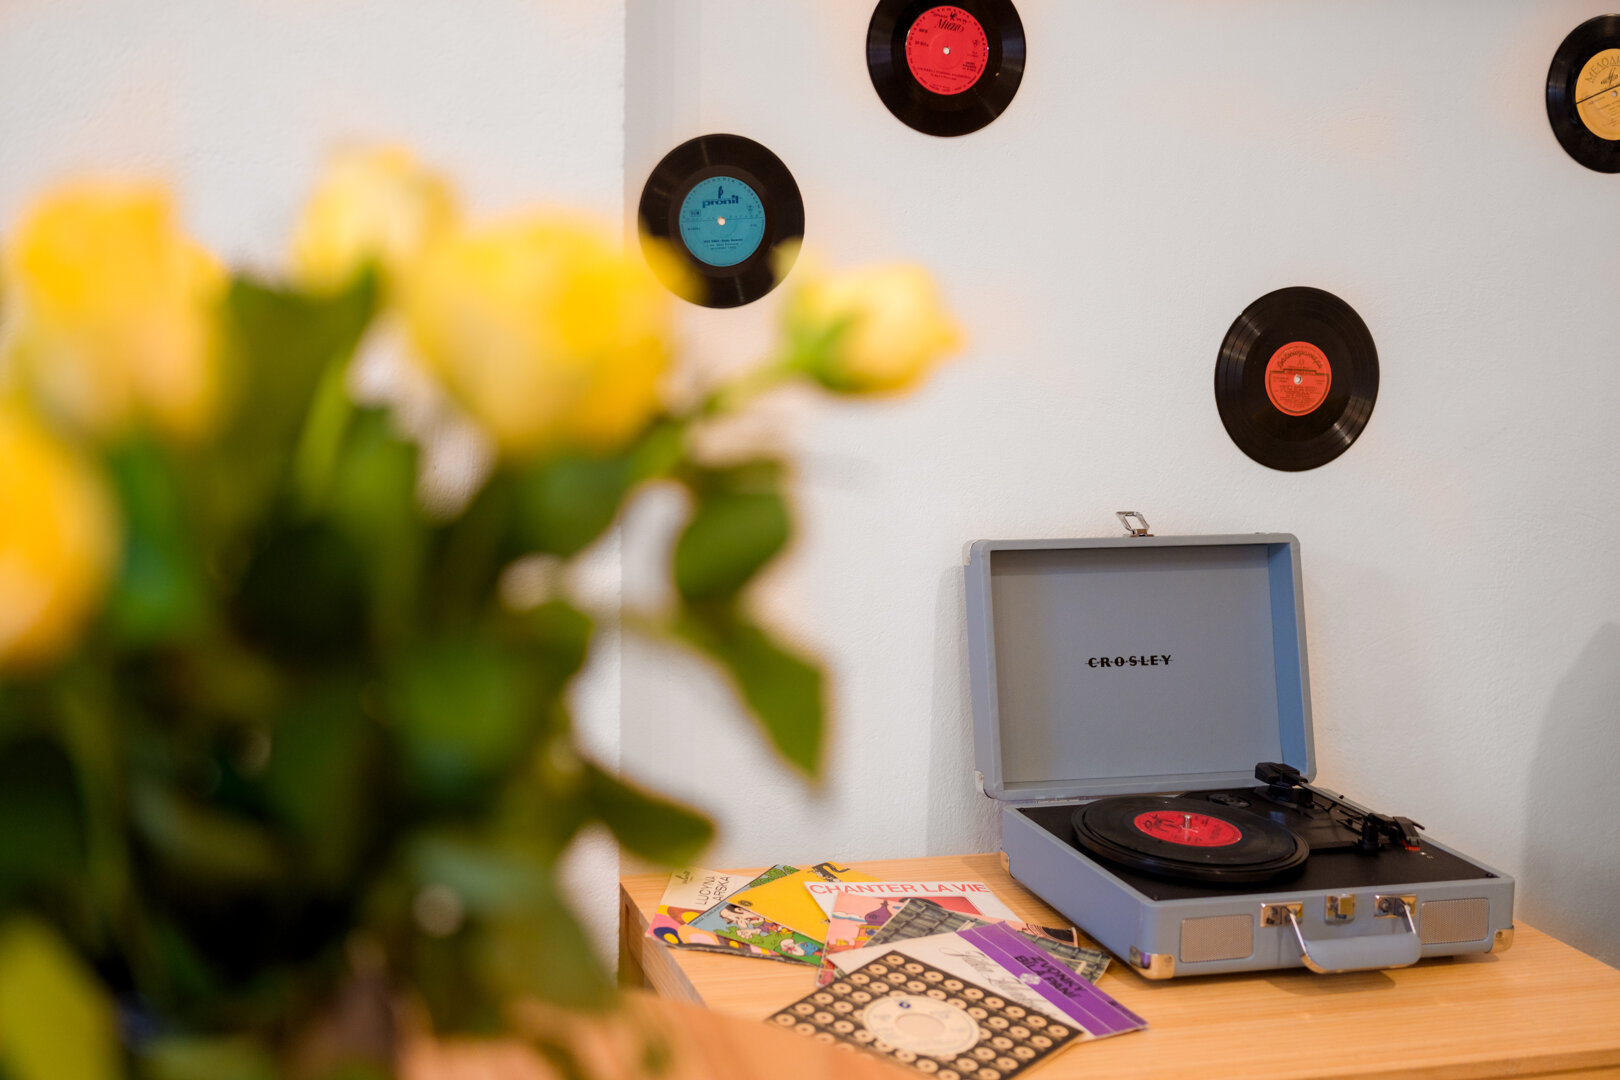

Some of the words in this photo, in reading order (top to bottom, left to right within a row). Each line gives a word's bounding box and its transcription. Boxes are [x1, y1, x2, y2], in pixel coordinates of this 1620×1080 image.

[702, 194, 739, 208] pronit
[1087, 654, 1171, 668] CROSLEY
[808, 884, 917, 895] CHANTER
[920, 884, 949, 893] LA
[951, 883, 992, 893] VIE
